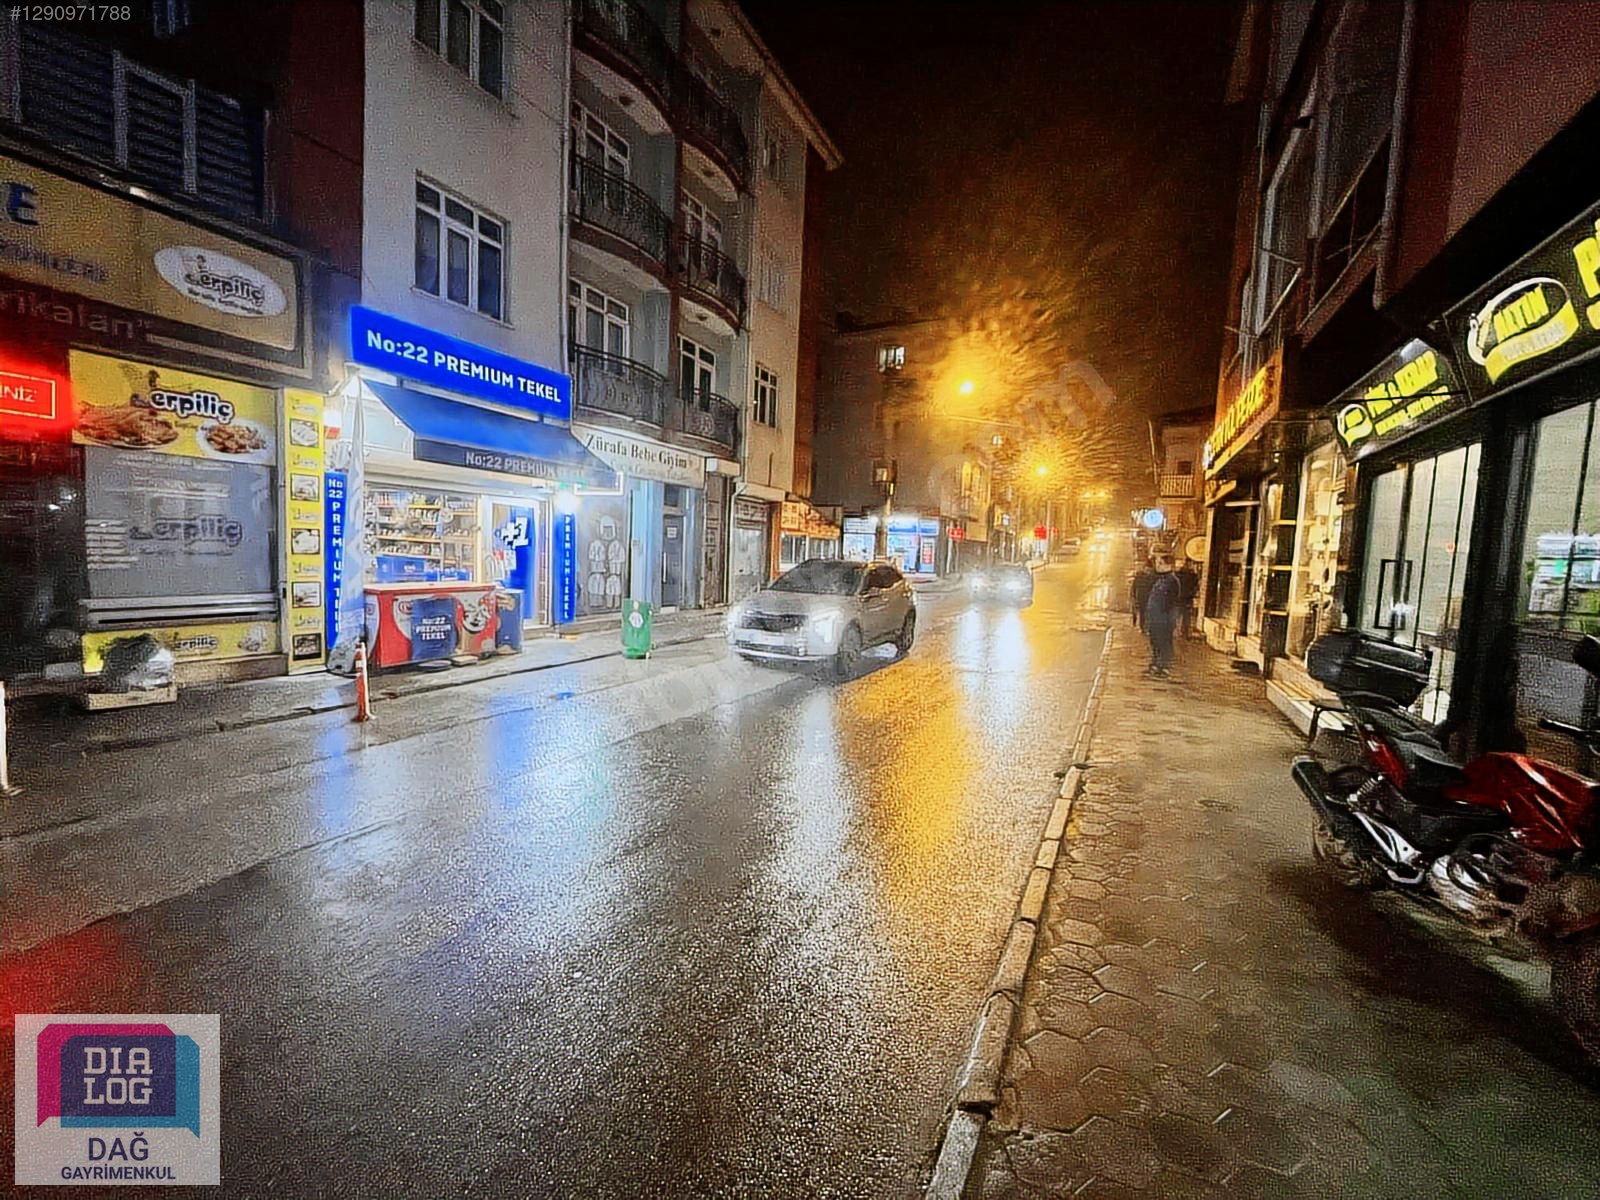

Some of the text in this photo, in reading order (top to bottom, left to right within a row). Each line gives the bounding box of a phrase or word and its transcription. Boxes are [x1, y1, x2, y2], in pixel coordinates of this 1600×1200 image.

[367, 329, 562, 403] No:22 PREMIUM TEKEL
[465, 452, 502, 469] No:22
[328, 489, 344, 498] 22
